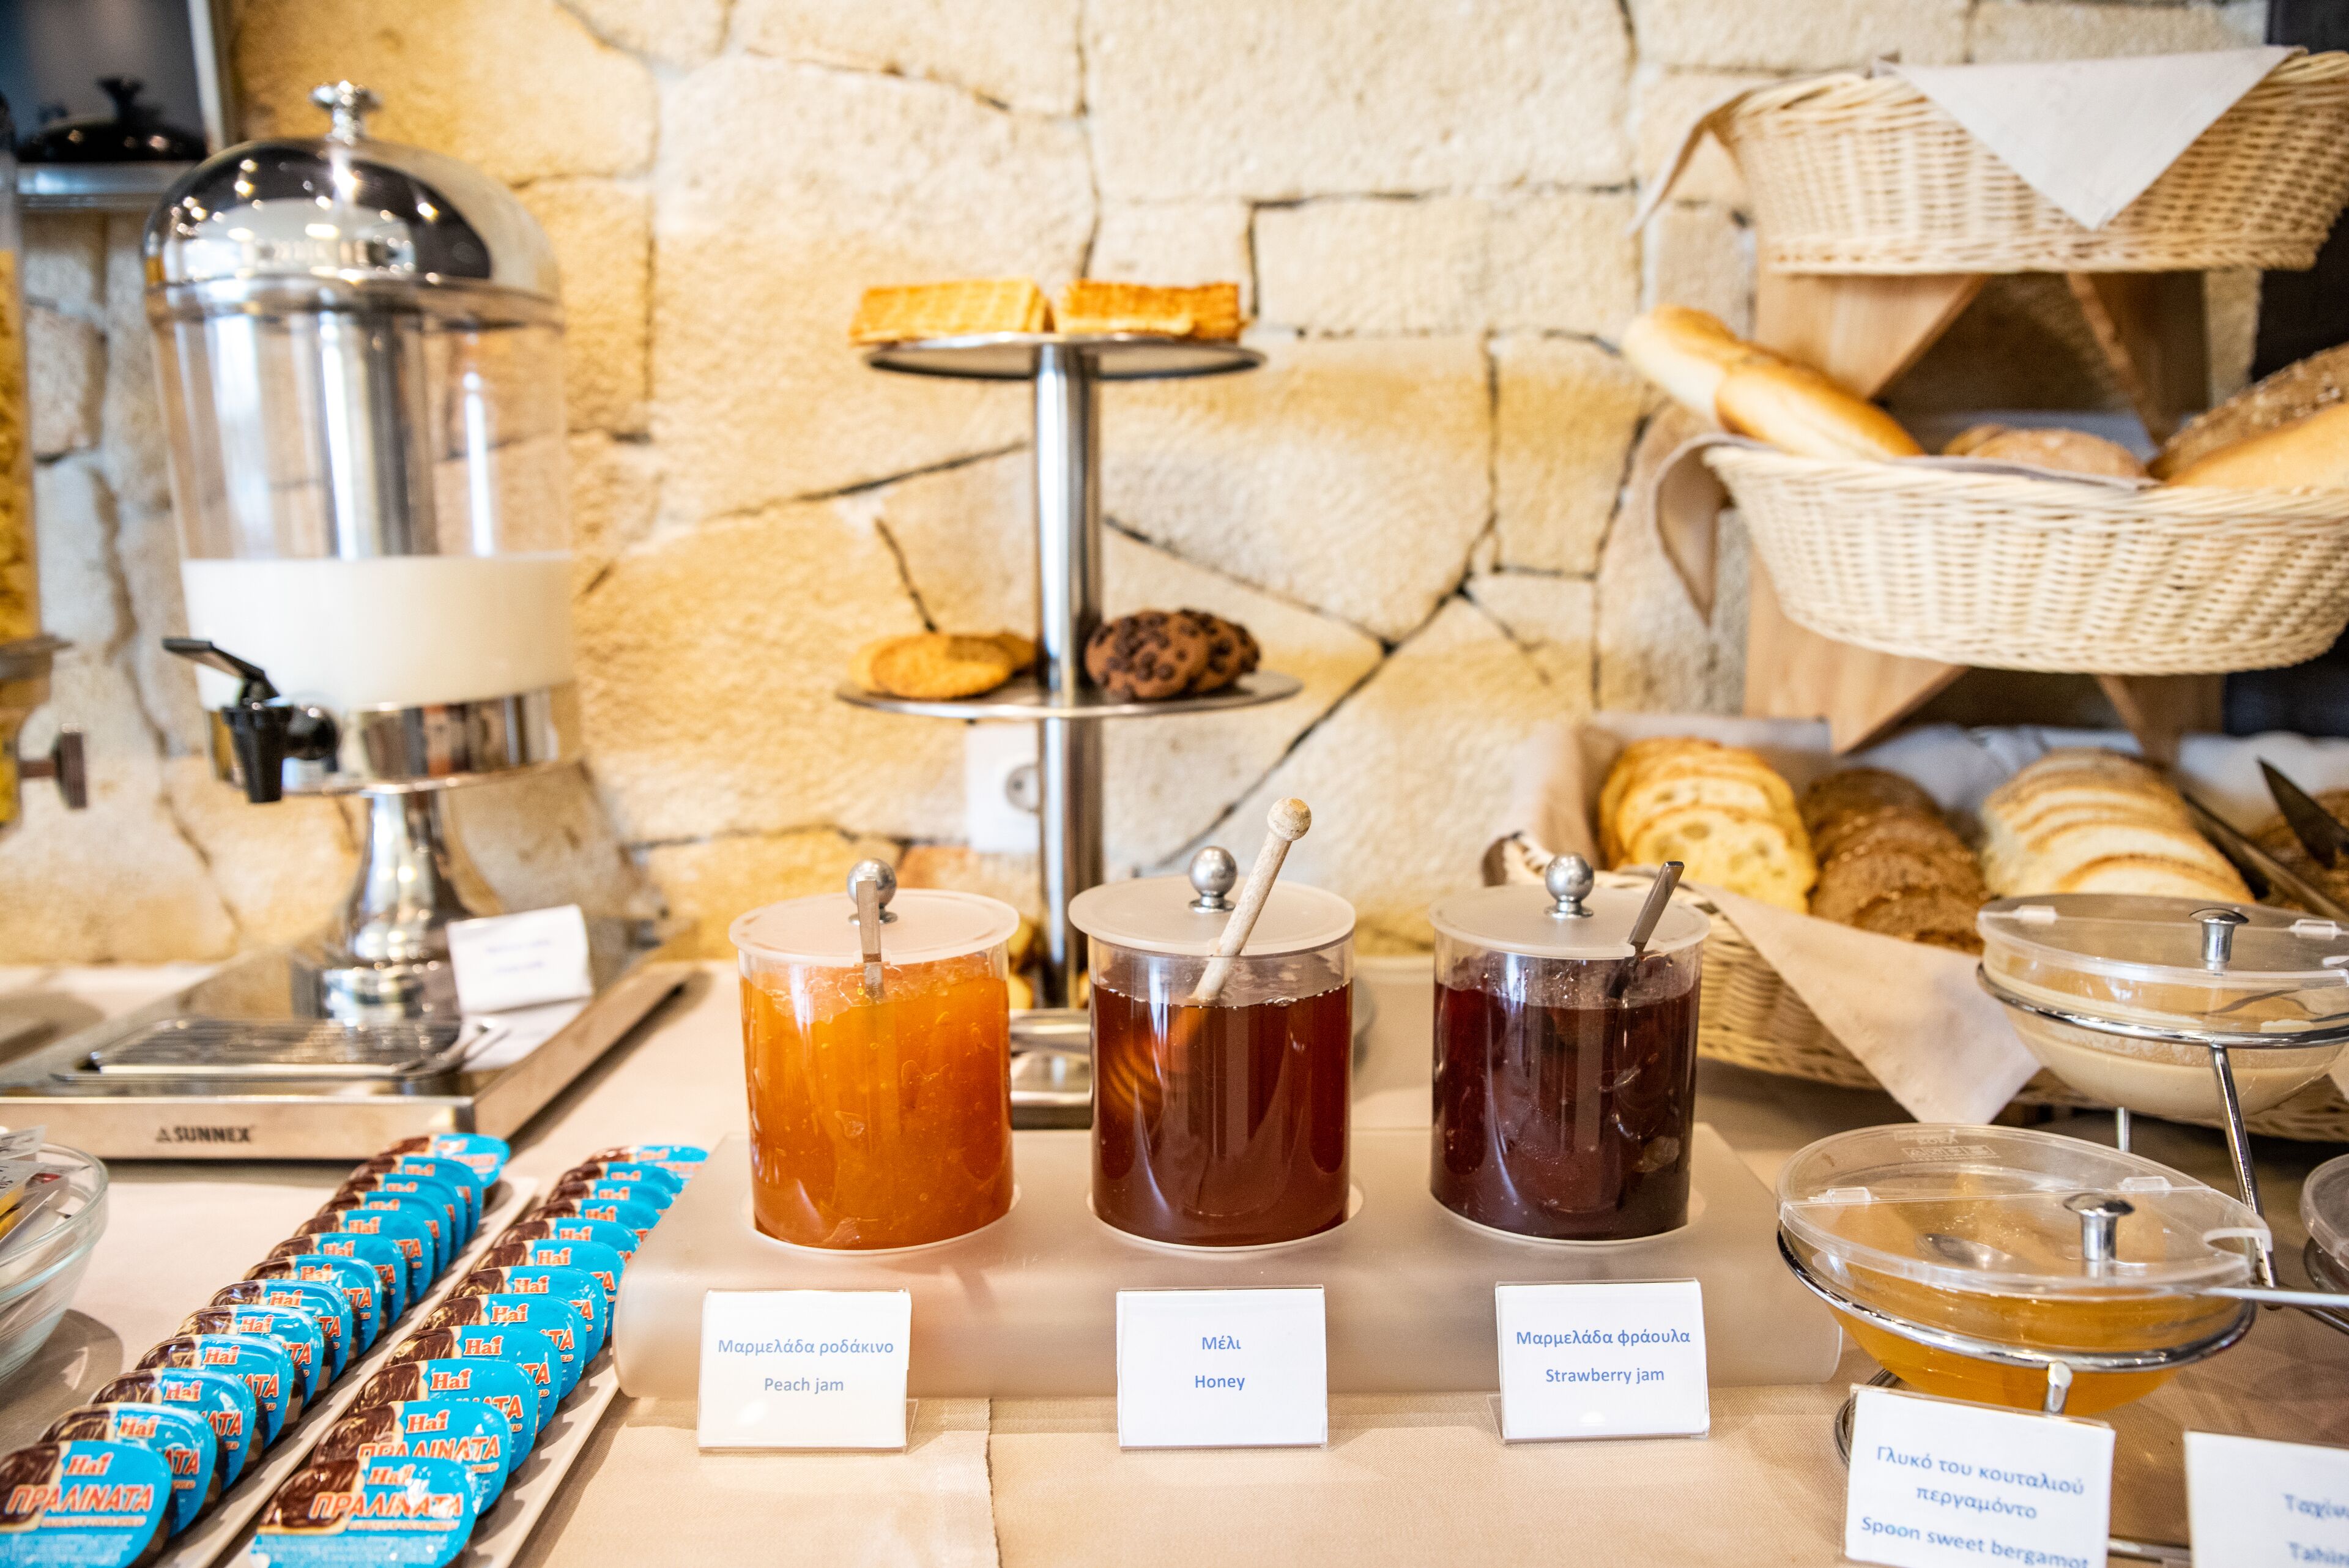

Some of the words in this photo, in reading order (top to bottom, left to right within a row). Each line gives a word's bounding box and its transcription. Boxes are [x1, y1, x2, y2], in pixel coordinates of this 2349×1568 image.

[174, 1126, 251, 1143] SUNNEX
[537, 1247, 572, 1266] Hai
[514, 1276, 549, 1294] Hai
[270, 1290, 303, 1307] Hai
[491, 1303, 530, 1323] Hai
[239, 1315, 275, 1333] Hai
[464, 1336, 503, 1356] Hai
[1202, 1336, 1241, 1350] Μέλι
[1516, 1329, 1613, 1347] Μαρμελάδα
[1617, 1328, 1691, 1346] φράουλα
[202, 1345, 240, 1365] Hai
[718, 1339, 815, 1356] Μαρμελάδα
[820, 1339, 894, 1356] ροδάκινο
[430, 1368, 473, 1392] Hai
[1195, 1375, 1245, 1391] Honey
[1546, 1369, 1631, 1384] Strawberry
[1636, 1368, 1664, 1384] jam
[164, 1381, 203, 1402] Hai
[765, 1378, 810, 1391] Peach
[815, 1378, 844, 1394] jam
[117, 1415, 160, 1438] Hai
[406, 1409, 450, 1434] Hai
[1877, 1445, 1932, 1469] Γλυκό
[1939, 1460, 1972, 1476] του
[1979, 1466, 2084, 1495] κουταλιού
[6, 1484, 153, 1514] ΠΡΑΛΙΝΑΤΑ
[1917, 1487, 2037, 1519] περγαμόντο
[1861, 1517, 1920, 1540] Spoon
[1927, 1531, 1985, 1553] sweet
